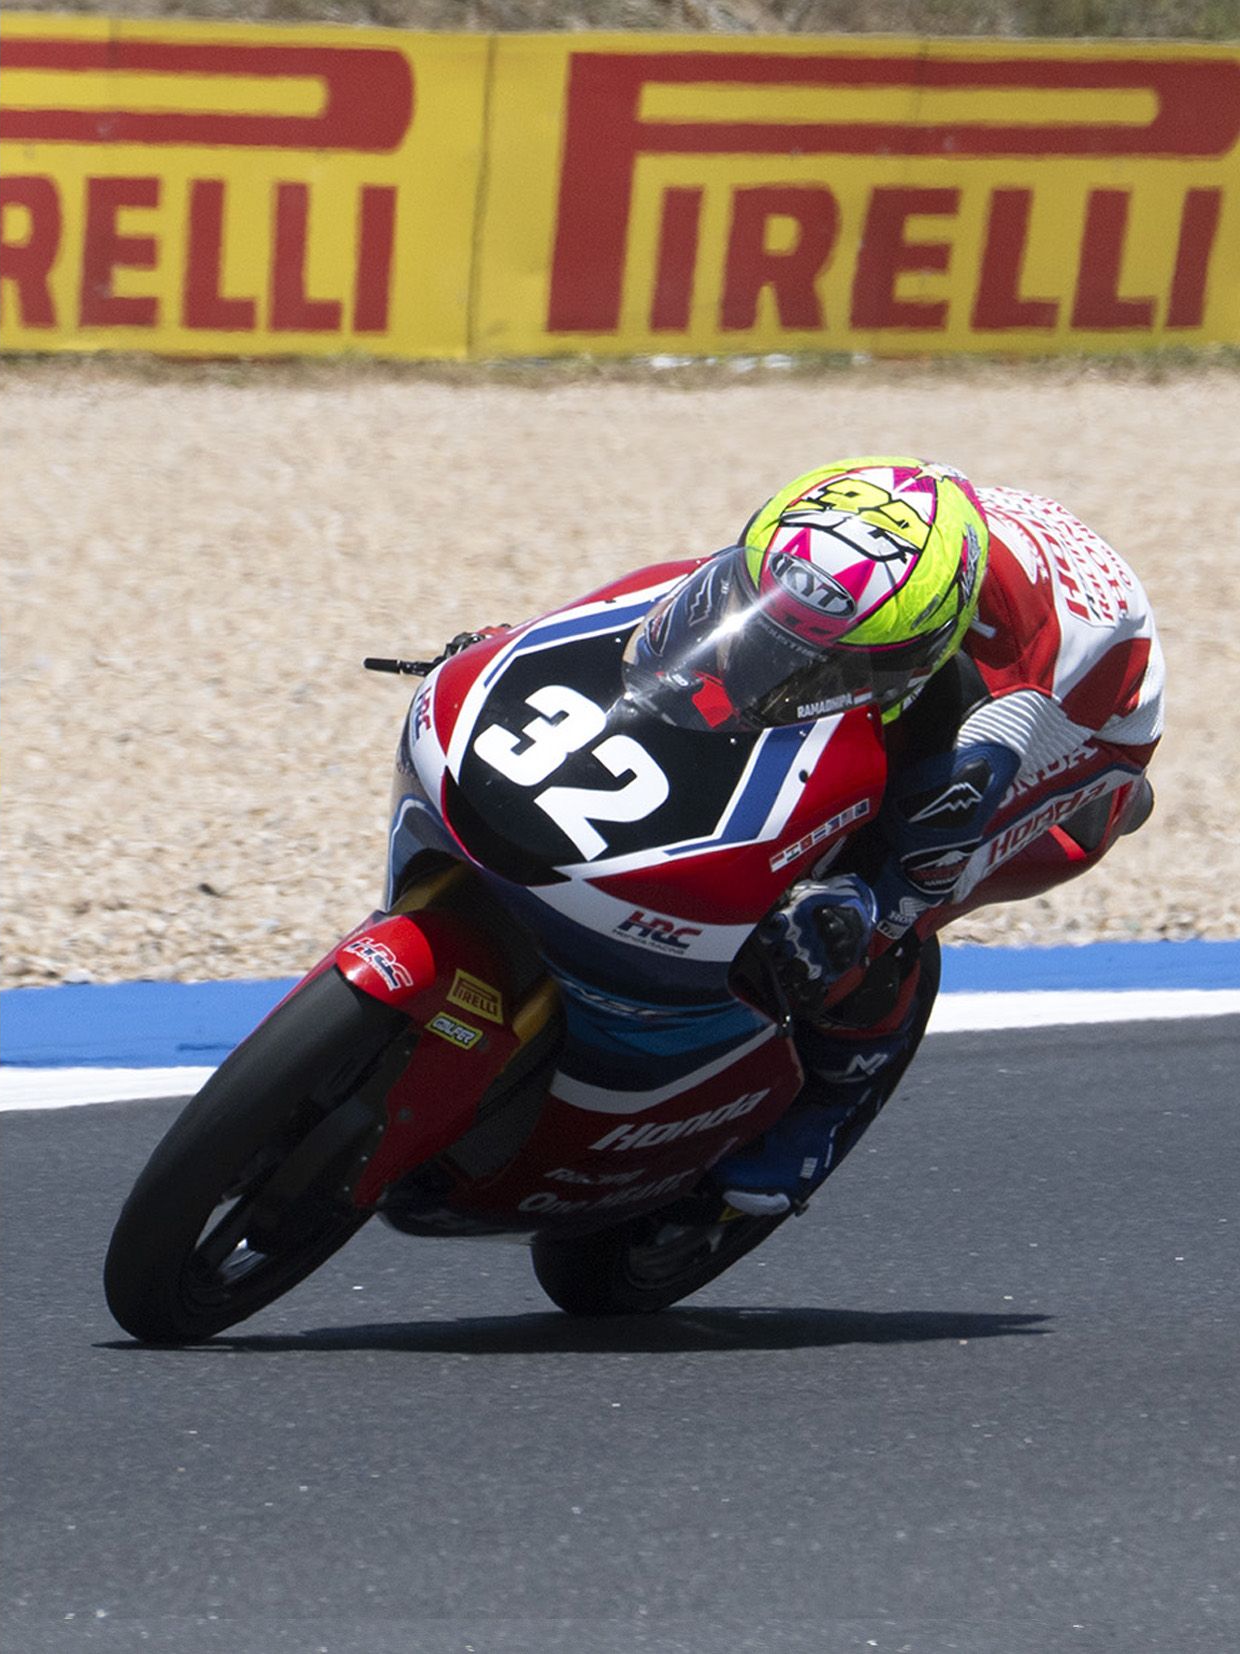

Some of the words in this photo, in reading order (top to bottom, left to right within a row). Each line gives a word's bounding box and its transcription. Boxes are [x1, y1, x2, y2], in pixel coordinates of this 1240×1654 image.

[546, 51, 1240, 333] PIRELLI
[473, 684, 670, 862] 32
[617, 910, 703, 950] HRC
[452, 976, 500, 1017] PIRELLI
[588, 1087, 772, 1152] Honda
